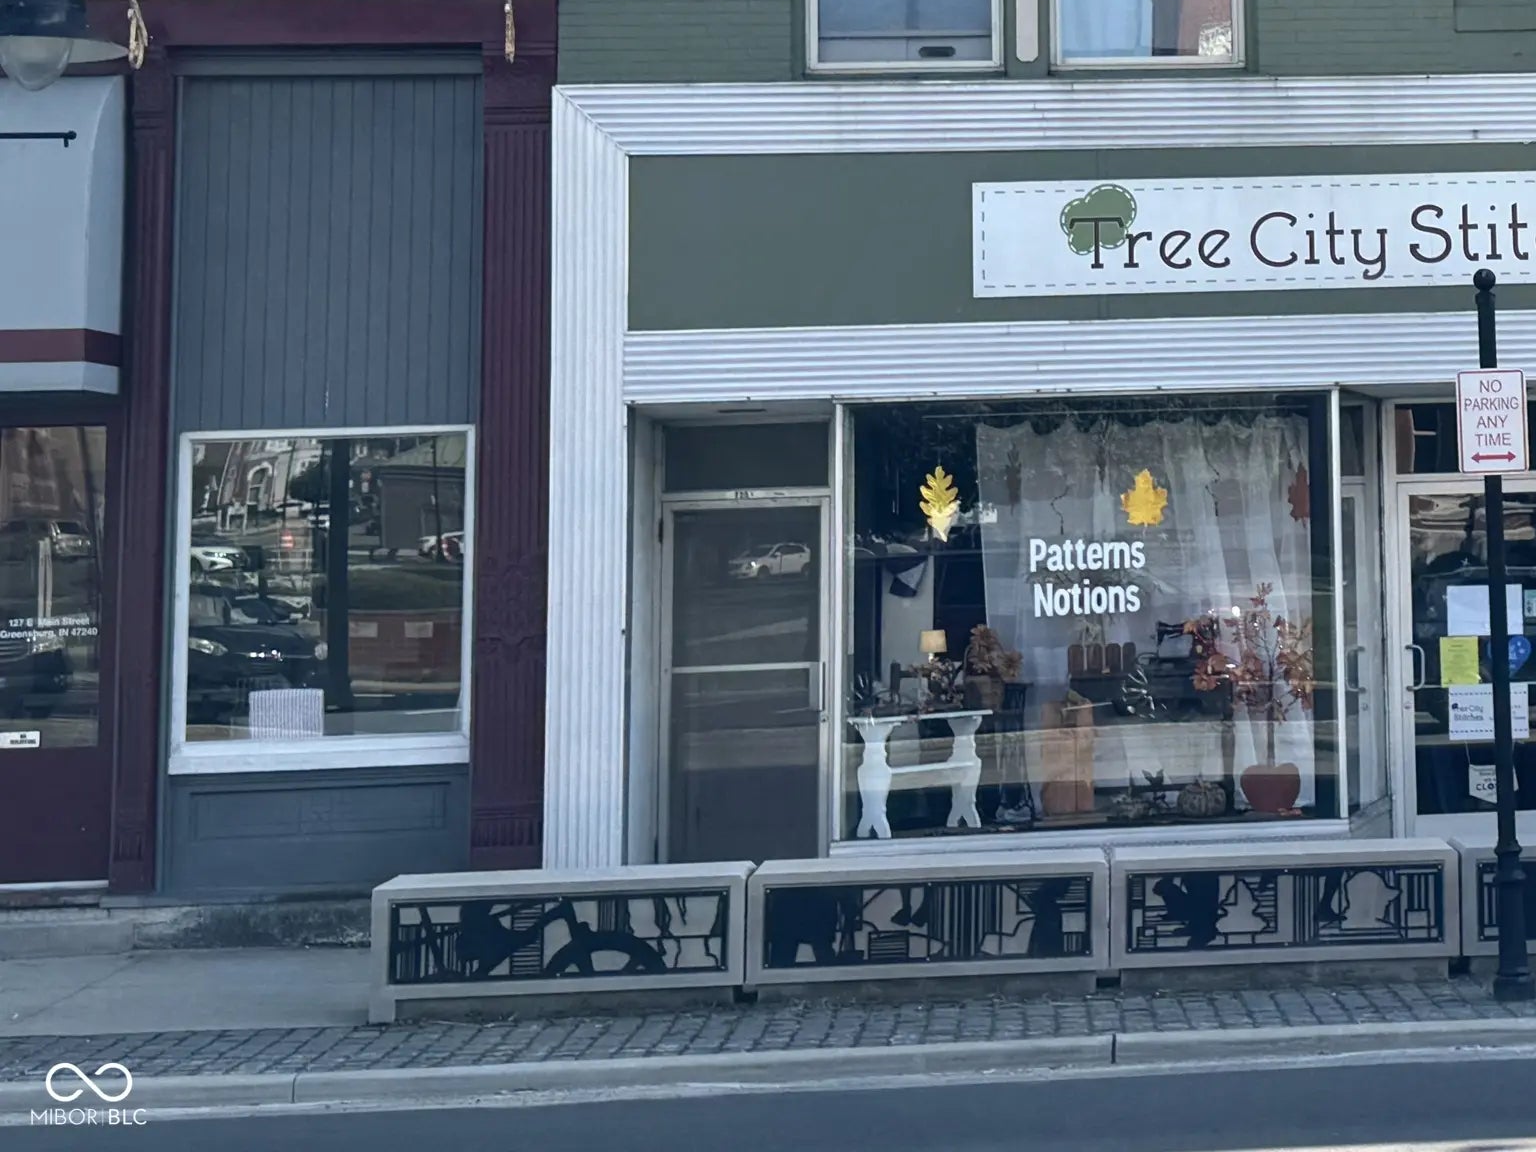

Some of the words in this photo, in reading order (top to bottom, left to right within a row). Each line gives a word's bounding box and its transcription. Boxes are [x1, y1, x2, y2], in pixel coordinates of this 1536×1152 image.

[1068, 215, 1231, 270] Tree
[1250, 211, 1388, 281] City
[1479, 379, 1503, 393] NO
[1463, 396, 1519, 411] PARKING
[1476, 415, 1508, 429] ANY
[1474, 432, 1512, 447] TIME
[1029, 538, 1146, 573] Patterns
[1033, 578, 1141, 618] Notions
